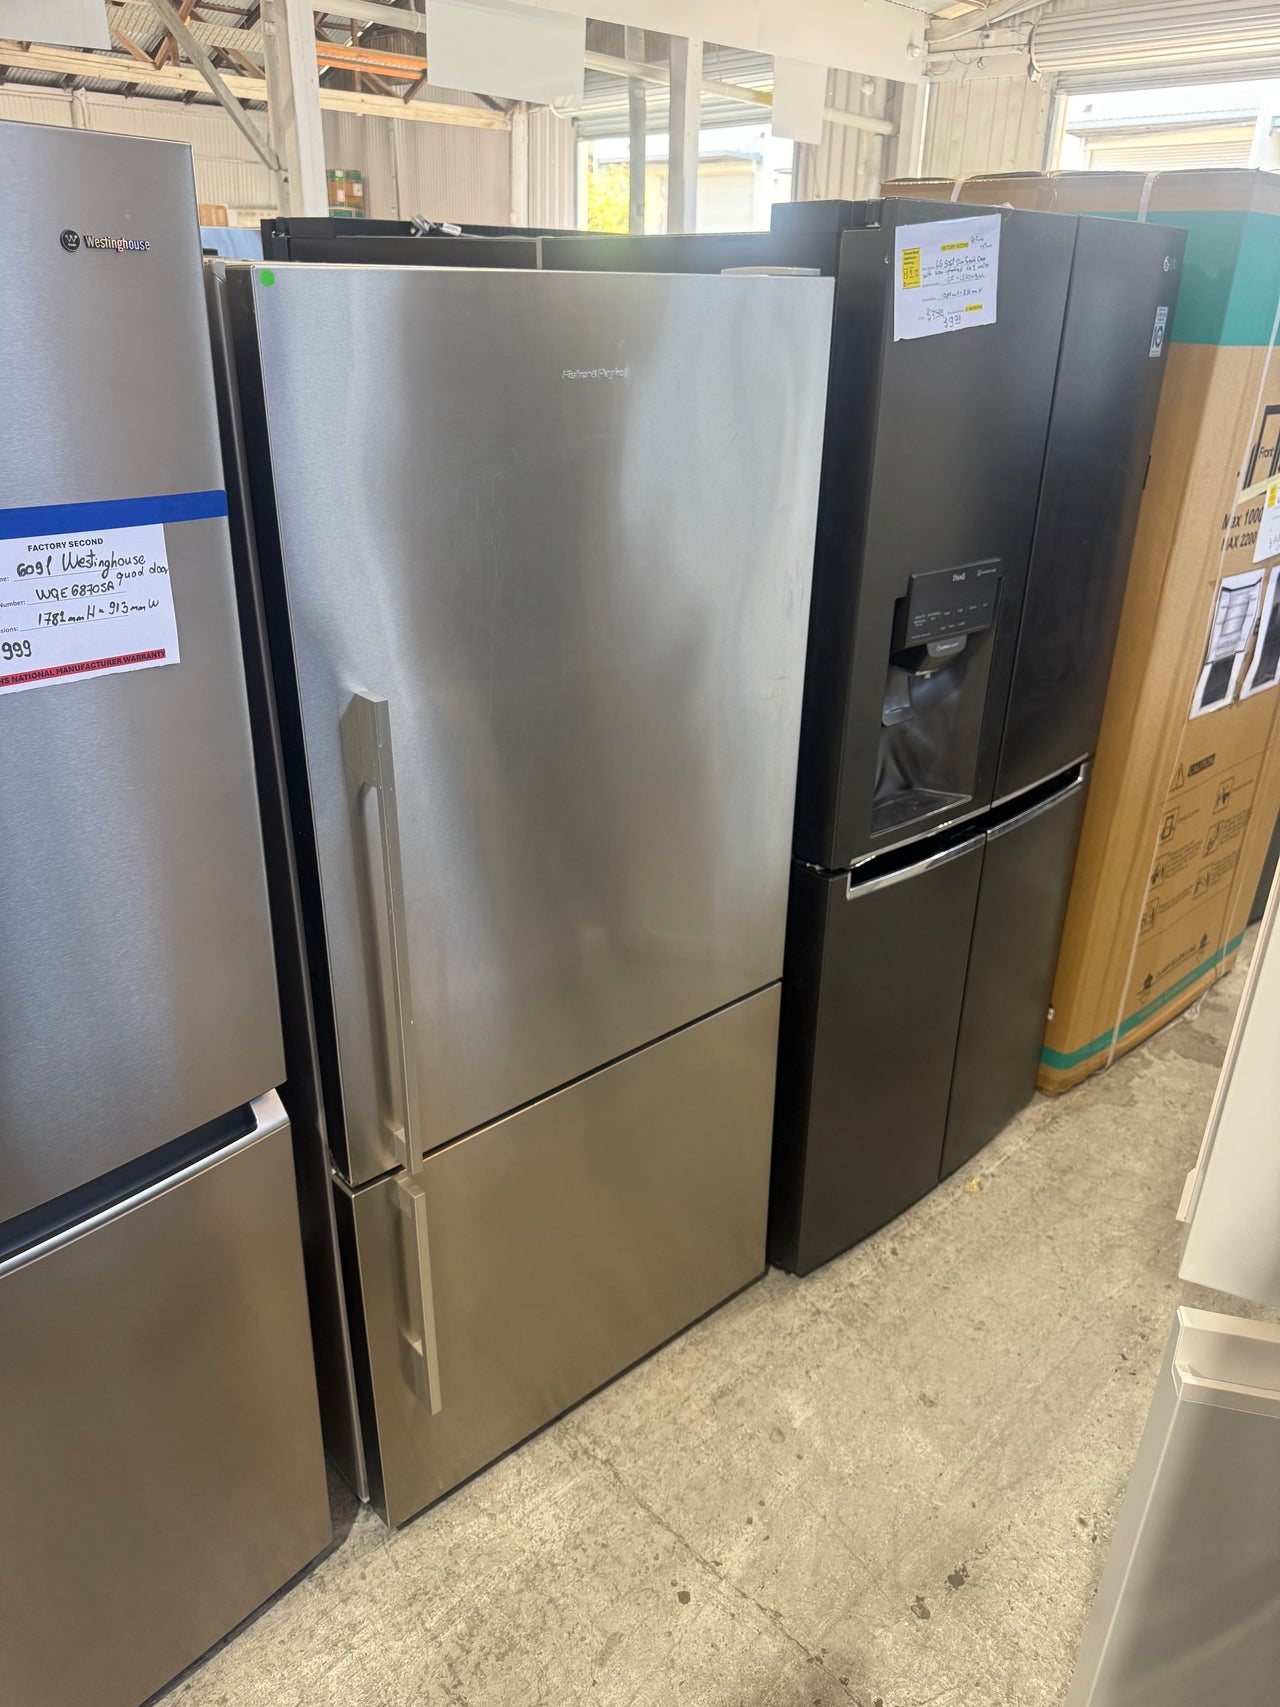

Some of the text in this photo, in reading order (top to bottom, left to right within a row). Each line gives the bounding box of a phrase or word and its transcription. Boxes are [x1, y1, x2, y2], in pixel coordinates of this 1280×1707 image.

[83, 235, 151, 252] Westinghouse
[27, 537, 104, 553] FACTORY SECOND
[62, 549, 146, 579] Westinghouse
[148, 562, 169, 575] door
[11, 669, 55, 684] NATIONAL
[56, 657, 123, 675] MANUFACTURER
[123, 649, 166, 664] WARRANTY
